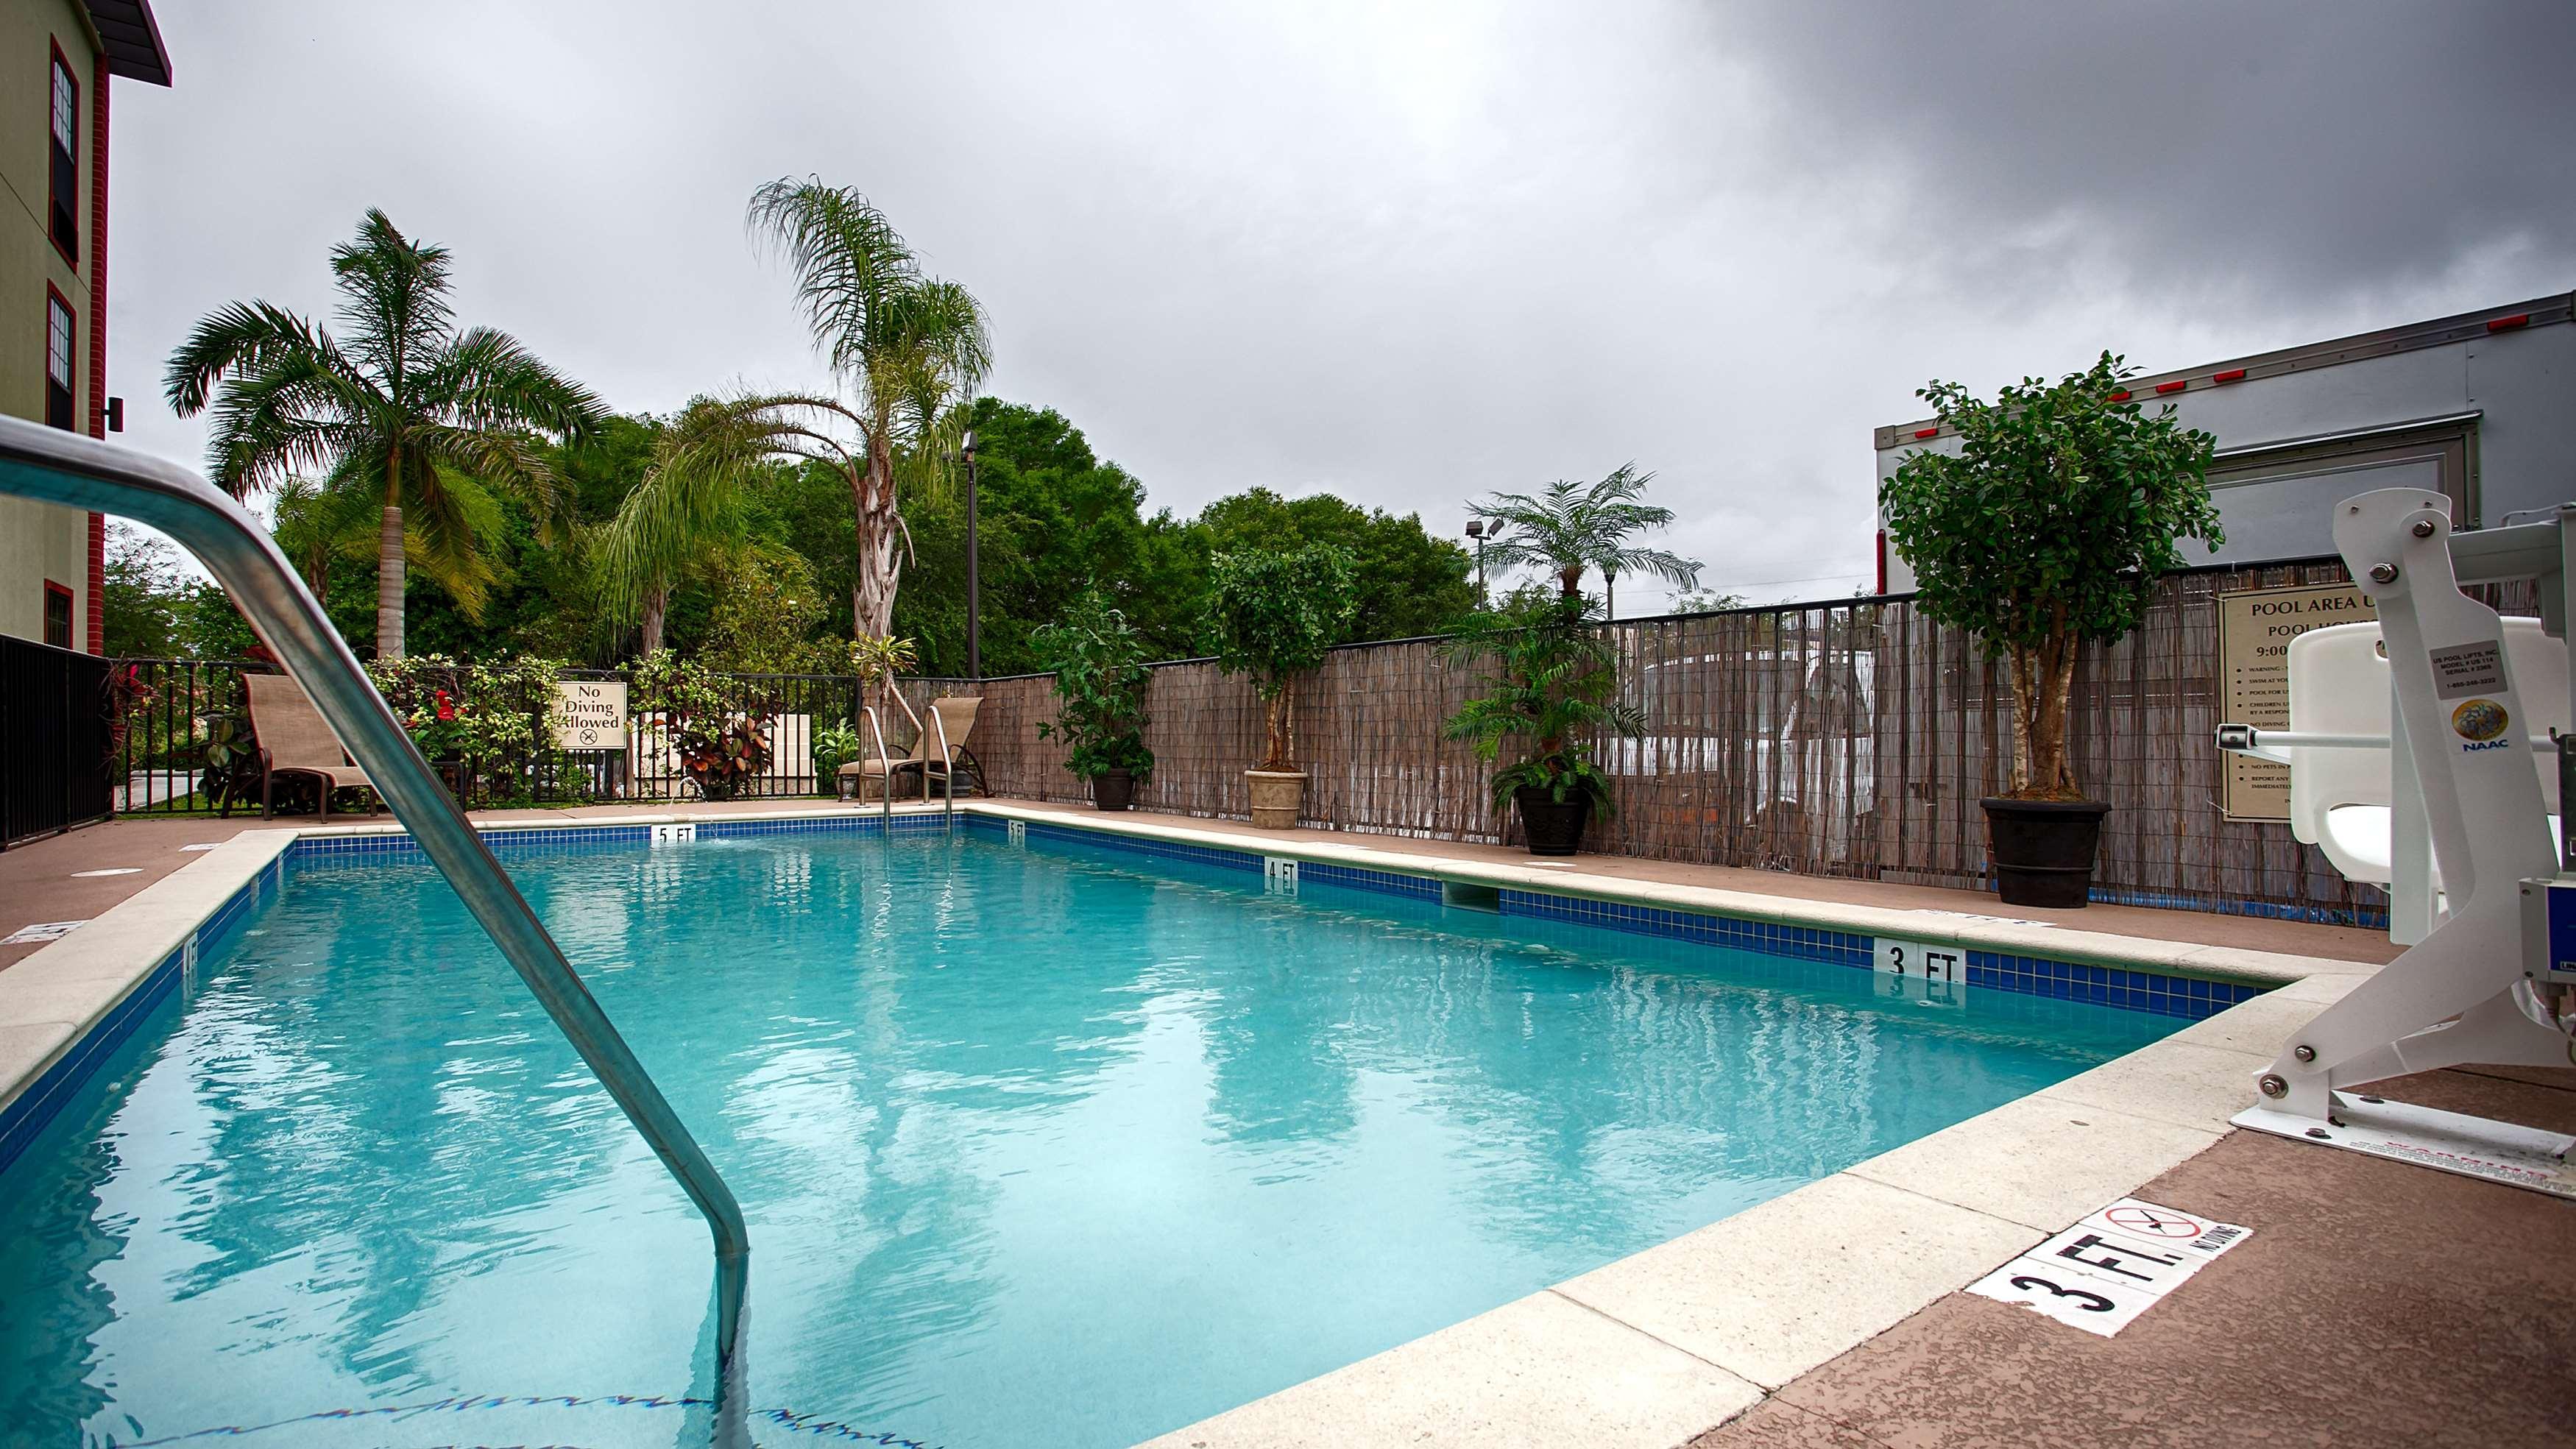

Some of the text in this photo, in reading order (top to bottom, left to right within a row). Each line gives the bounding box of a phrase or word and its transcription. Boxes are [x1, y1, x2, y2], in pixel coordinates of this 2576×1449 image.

[2252, 601, 2303, 617] POOL
[2307, 596, 2357, 612] AREA
[2257, 645, 2287, 657] 9:00
[2445, 667, 2469, 676] SERIAL
[578, 685, 601, 698] No
[565, 700, 614, 717] Diving
[2463, 739, 2508, 752] NAAC
[659, 827, 692, 843] 5 FT
[1270, 861, 1295, 881] 4 FT
[1889, 946, 1905, 974] 3
[2188, 1225, 2242, 1253] NO DIVING
[2010, 1233, 2184, 1312] 3 FT.
